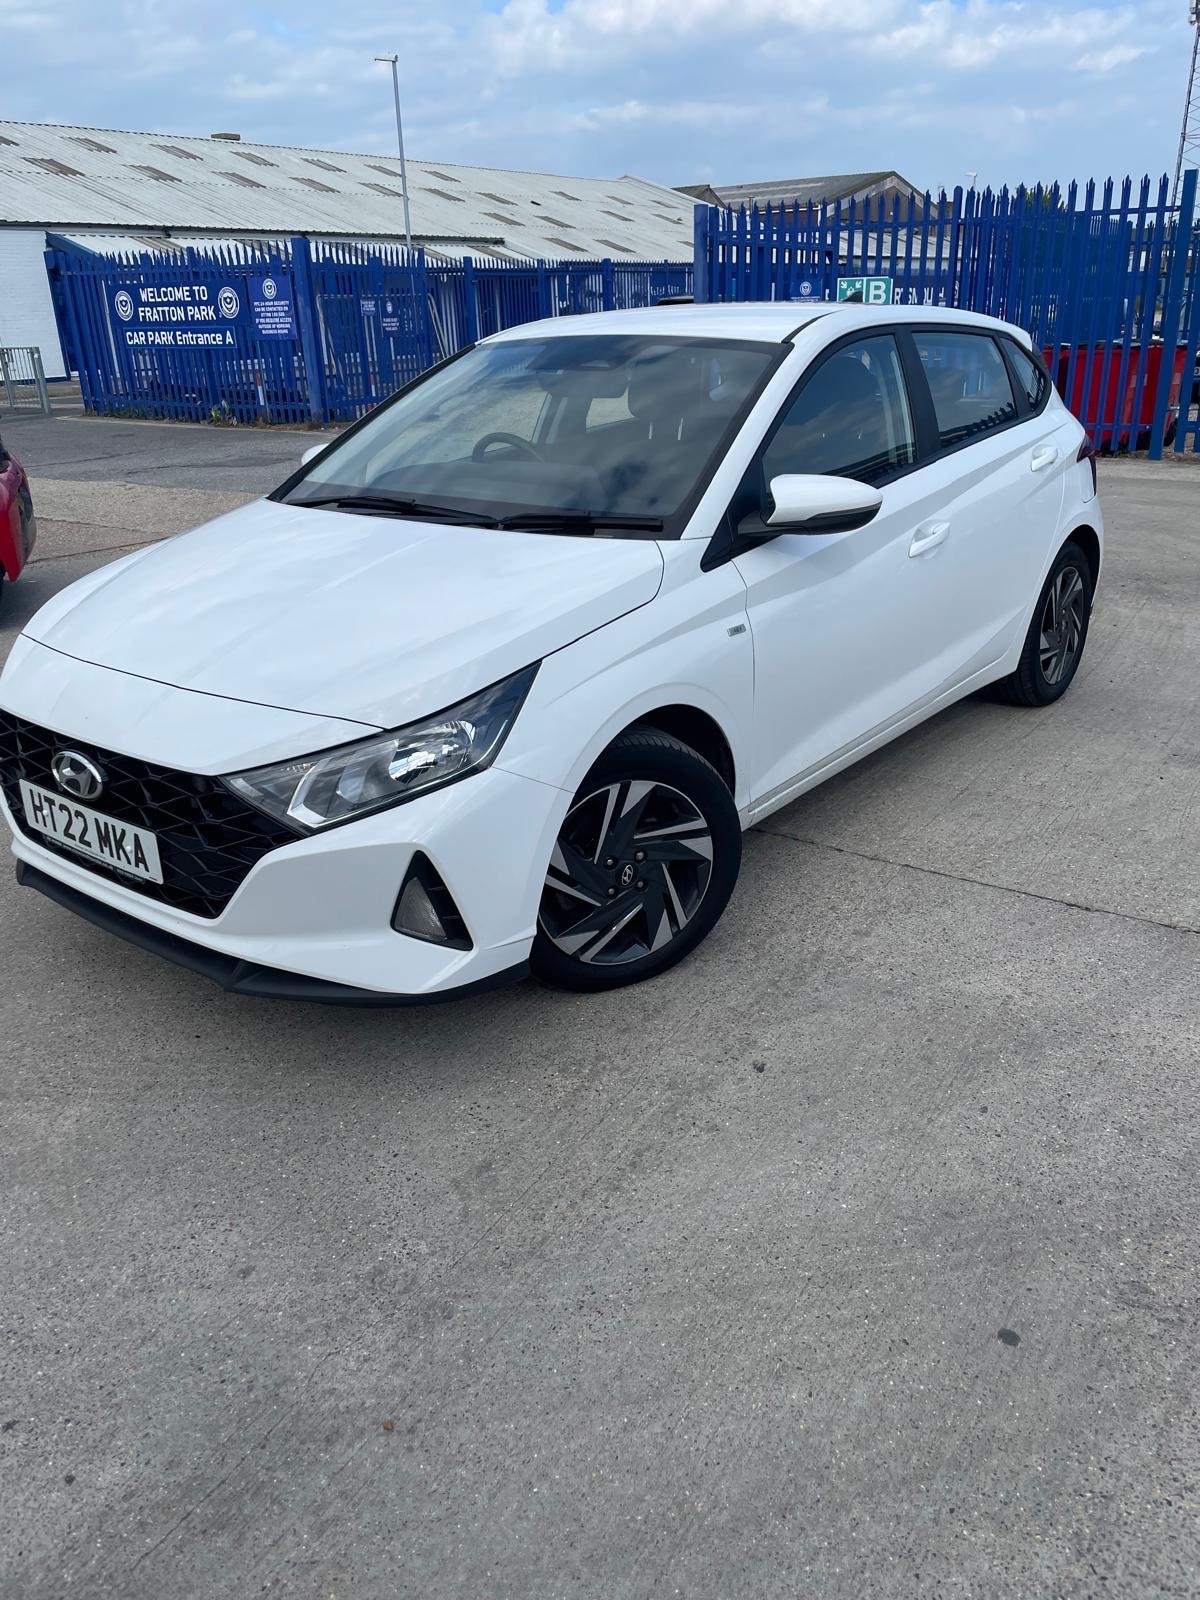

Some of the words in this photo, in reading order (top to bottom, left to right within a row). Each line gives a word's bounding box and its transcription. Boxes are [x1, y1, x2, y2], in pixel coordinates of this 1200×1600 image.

[139, 286, 192, 303] WELCOME
[192, 285, 208, 301] TO
[869, 281, 886, 304] B
[138, 306, 186, 322] FRATTON
[187, 305, 217, 321] PARK
[125, 331, 147, 345] CAR
[147, 331, 174, 345] PARK
[176, 331, 223, 345] Entrance
[225, 330, 234, 345] A
[29, 788, 92, 849] HT22
[94, 817, 150, 873] MKA
